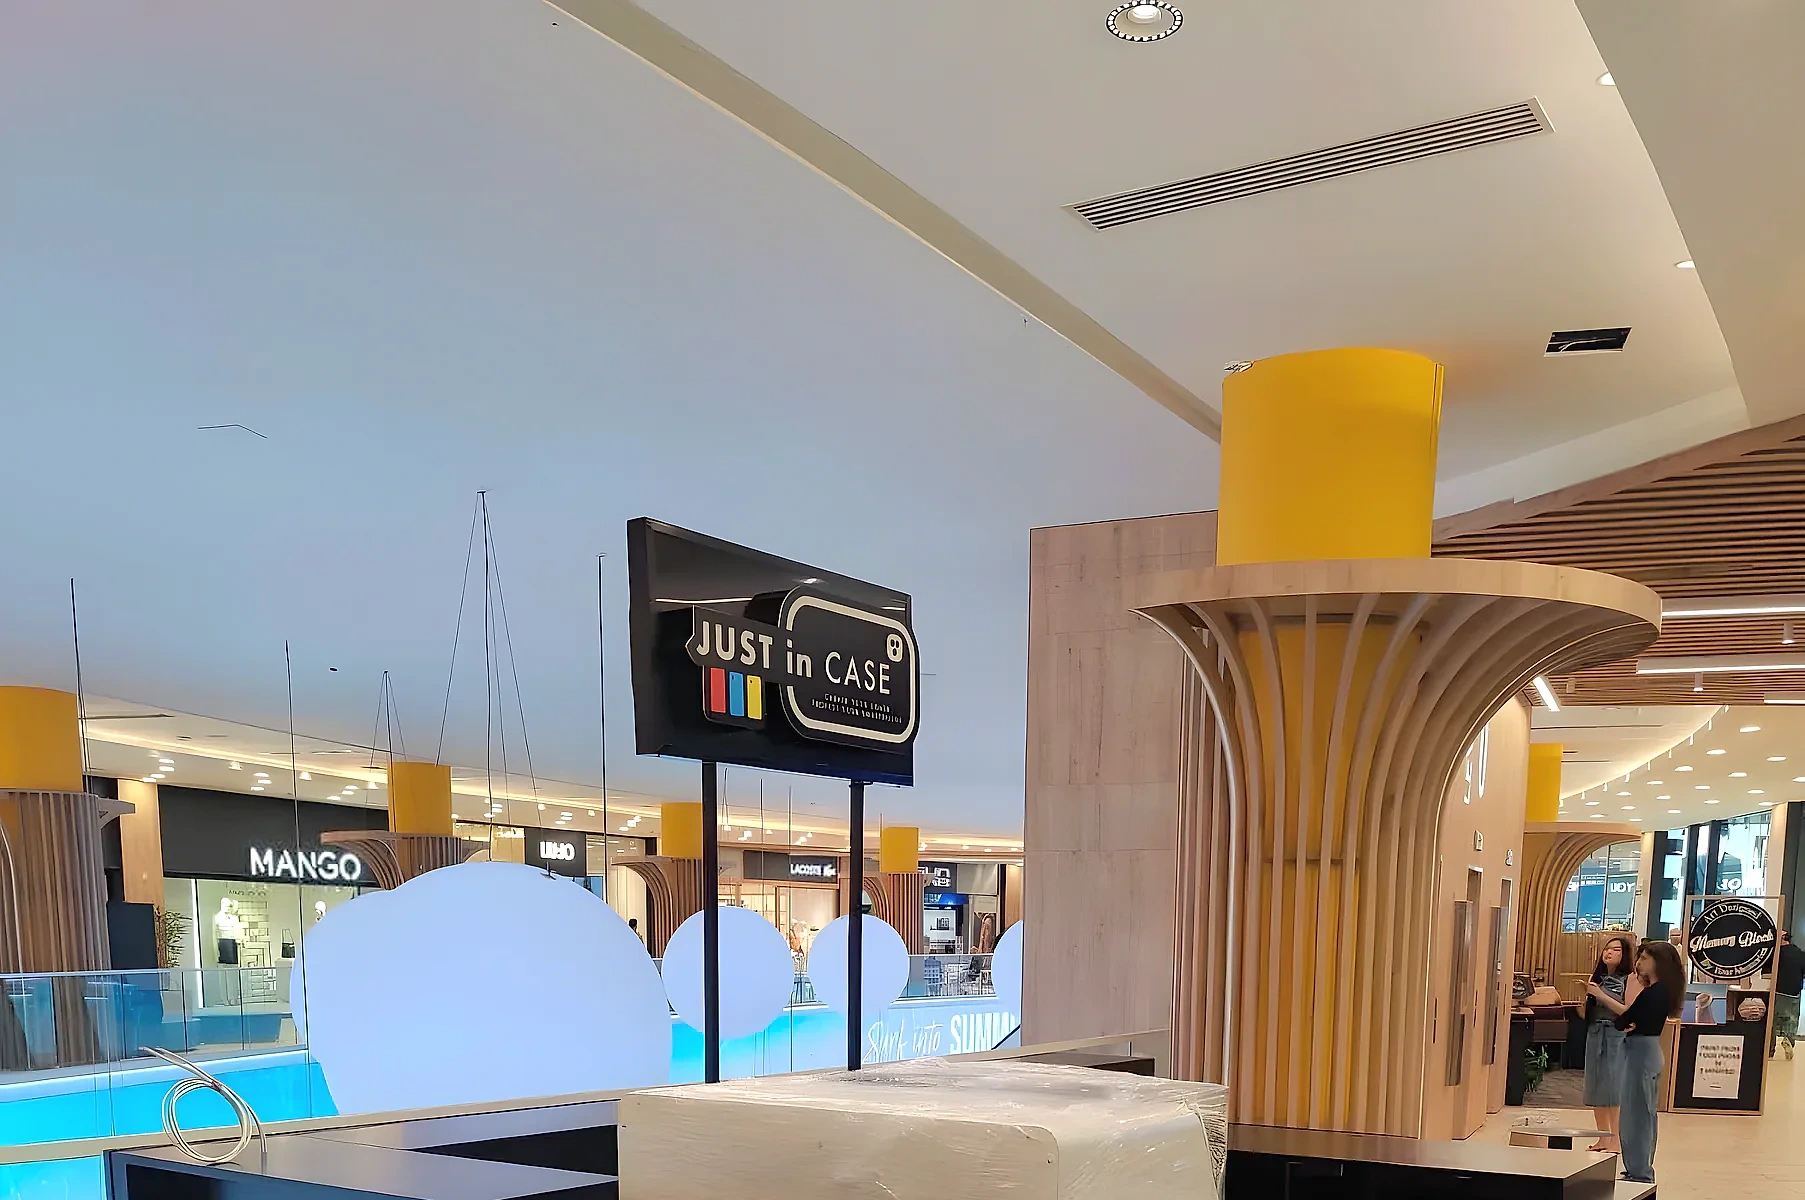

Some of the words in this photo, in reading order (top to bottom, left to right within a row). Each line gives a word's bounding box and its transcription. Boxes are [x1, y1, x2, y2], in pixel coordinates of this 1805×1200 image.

[696, 621, 773, 669] JUST
[786, 638, 812, 678] in
[825, 651, 891, 695] CASE
[250, 846, 361, 881] MANGO
[912, 1020, 944, 1056] into
